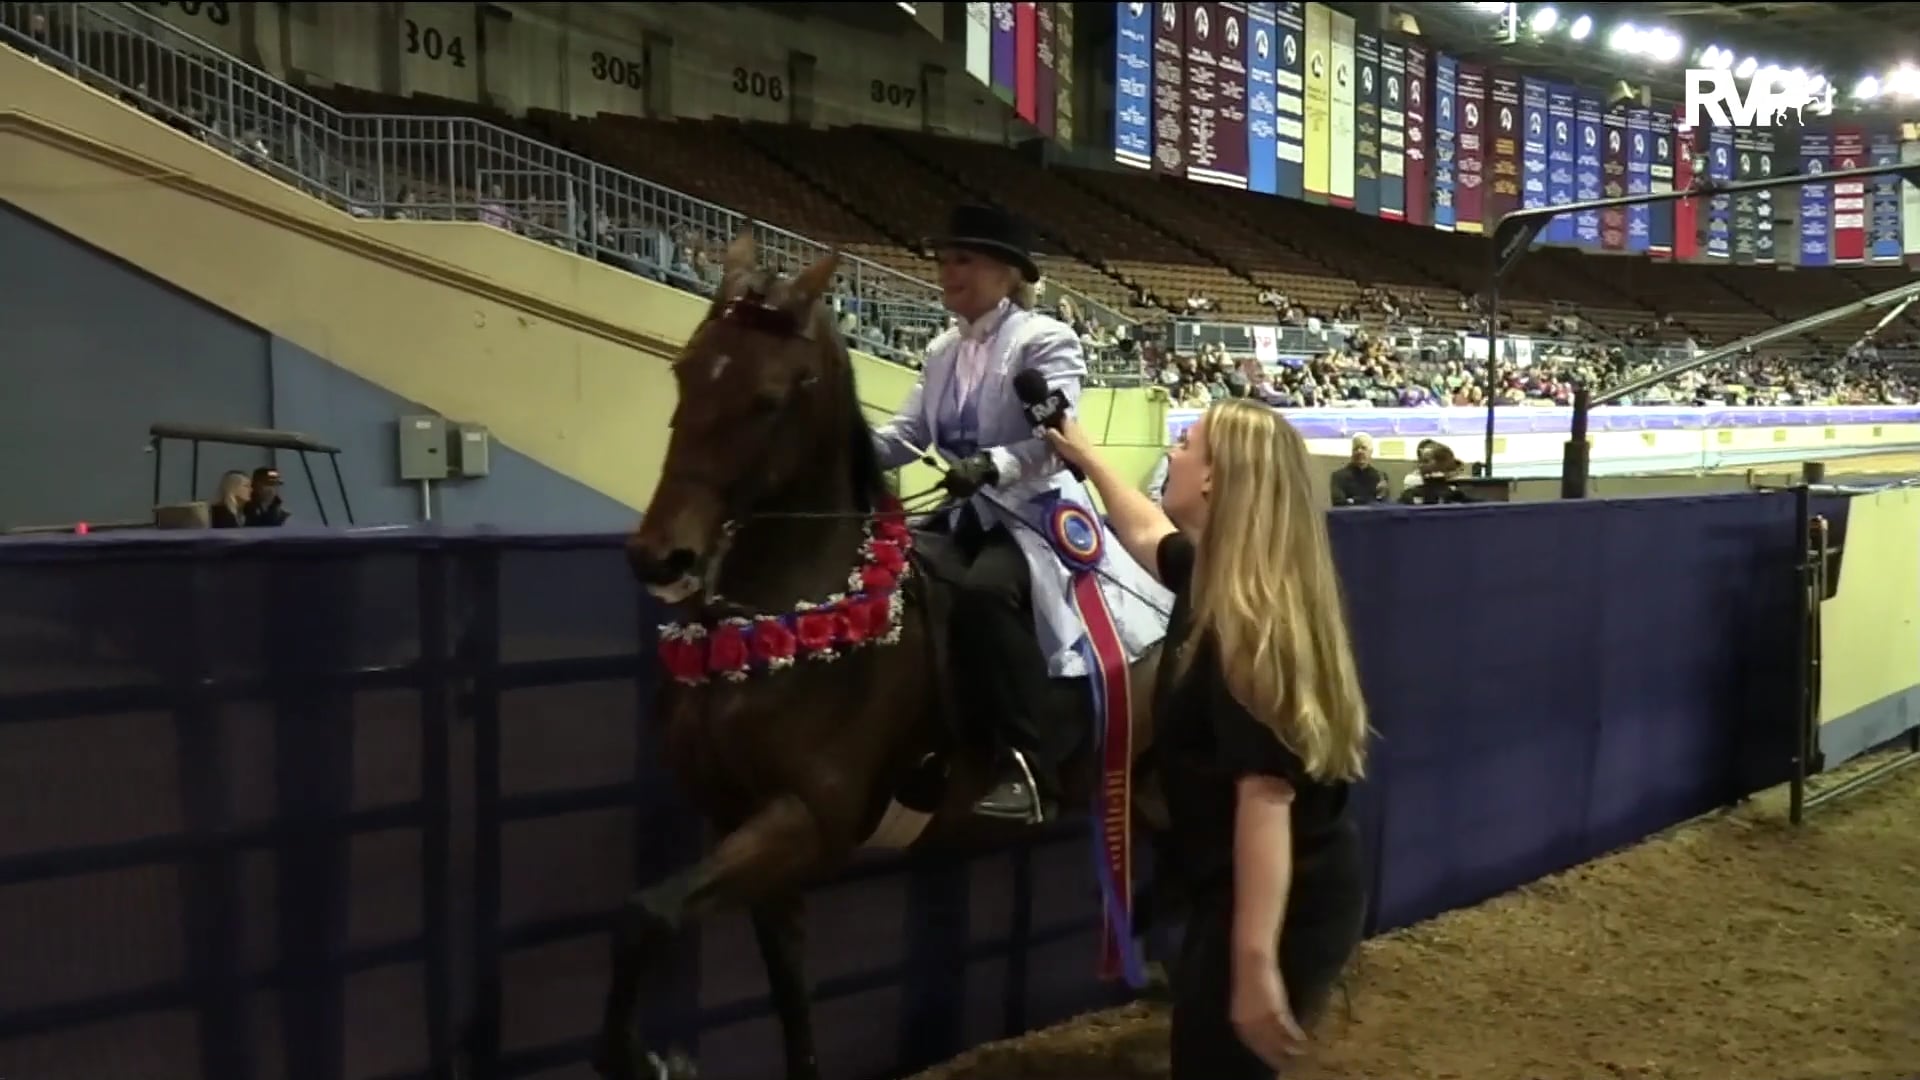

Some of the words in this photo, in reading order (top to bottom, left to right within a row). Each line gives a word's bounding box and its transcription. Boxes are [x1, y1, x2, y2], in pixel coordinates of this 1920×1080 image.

[406, 19, 465, 67] 304
[591, 51, 641, 90] 305
[733, 66, 783, 102] 306
[871, 79, 916, 109] 307
